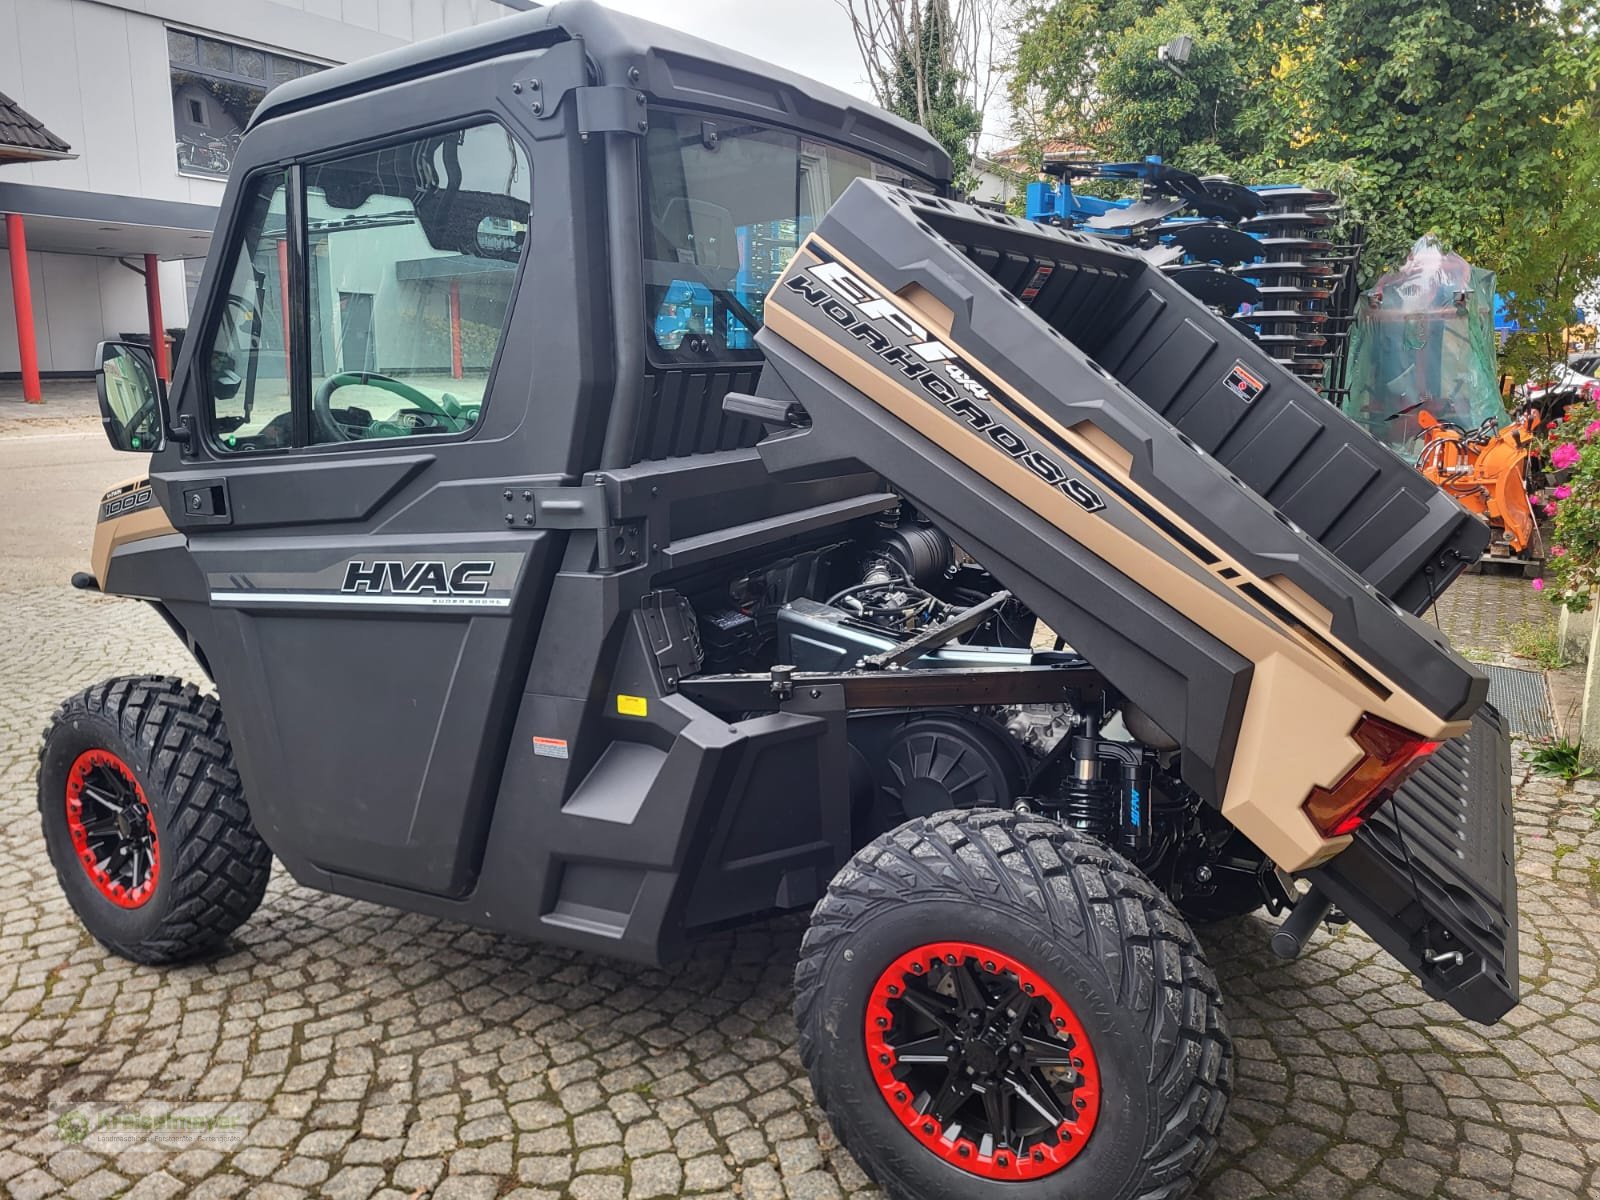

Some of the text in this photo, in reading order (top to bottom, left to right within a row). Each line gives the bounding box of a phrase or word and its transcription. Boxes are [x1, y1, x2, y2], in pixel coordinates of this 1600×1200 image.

[783, 274, 1107, 514] WORKCROSS
[105, 487, 152, 517] 1000
[340, 560, 495, 595] HVAC
